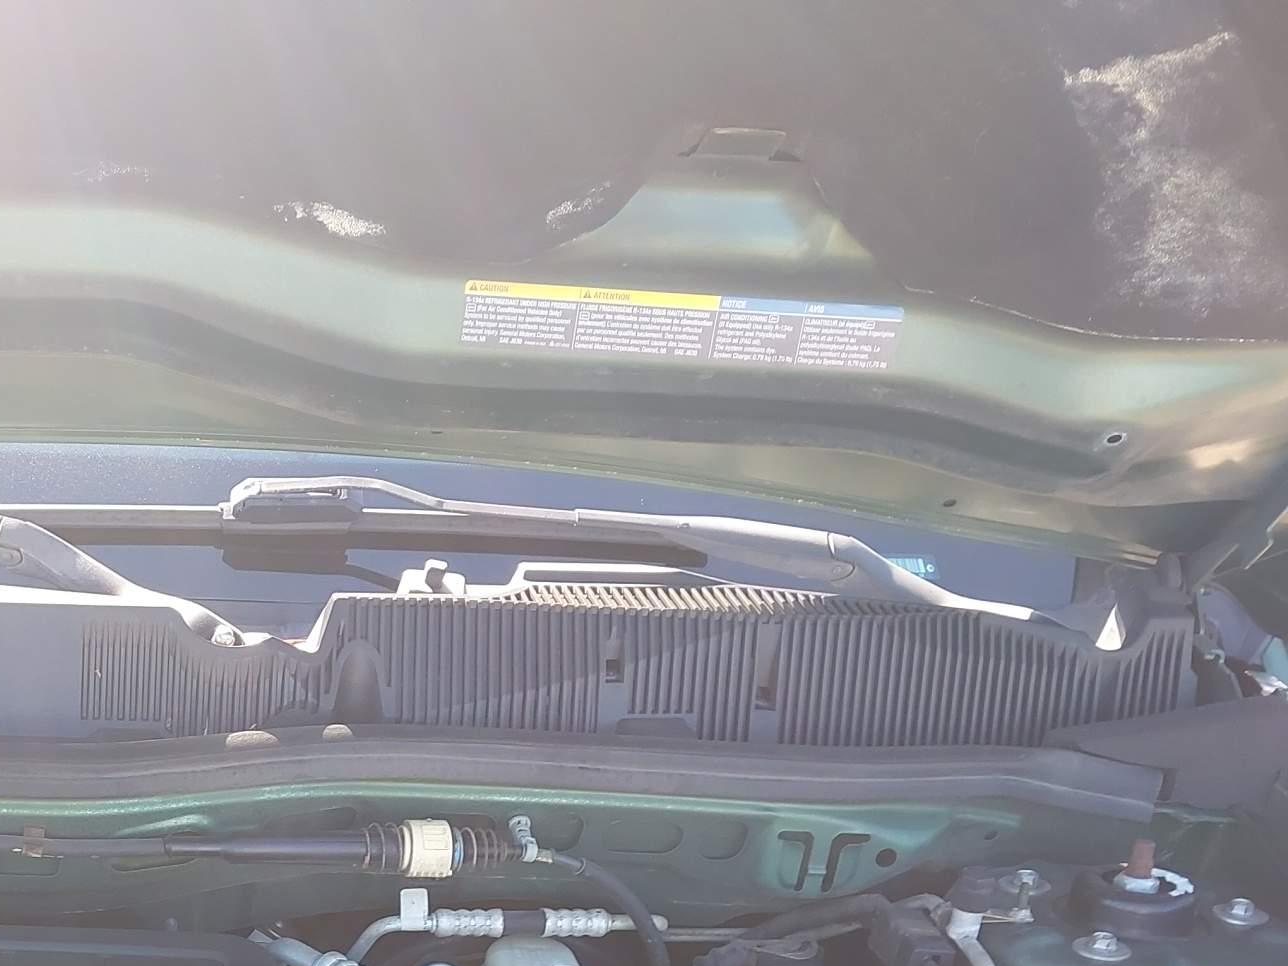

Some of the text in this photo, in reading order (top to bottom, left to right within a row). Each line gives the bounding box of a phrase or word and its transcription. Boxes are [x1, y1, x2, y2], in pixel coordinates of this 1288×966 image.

[480, 284, 509, 292] CAUTION
[593, 291, 630, 300] ATTENTION
[722, 298, 746, 309] NOTICE
